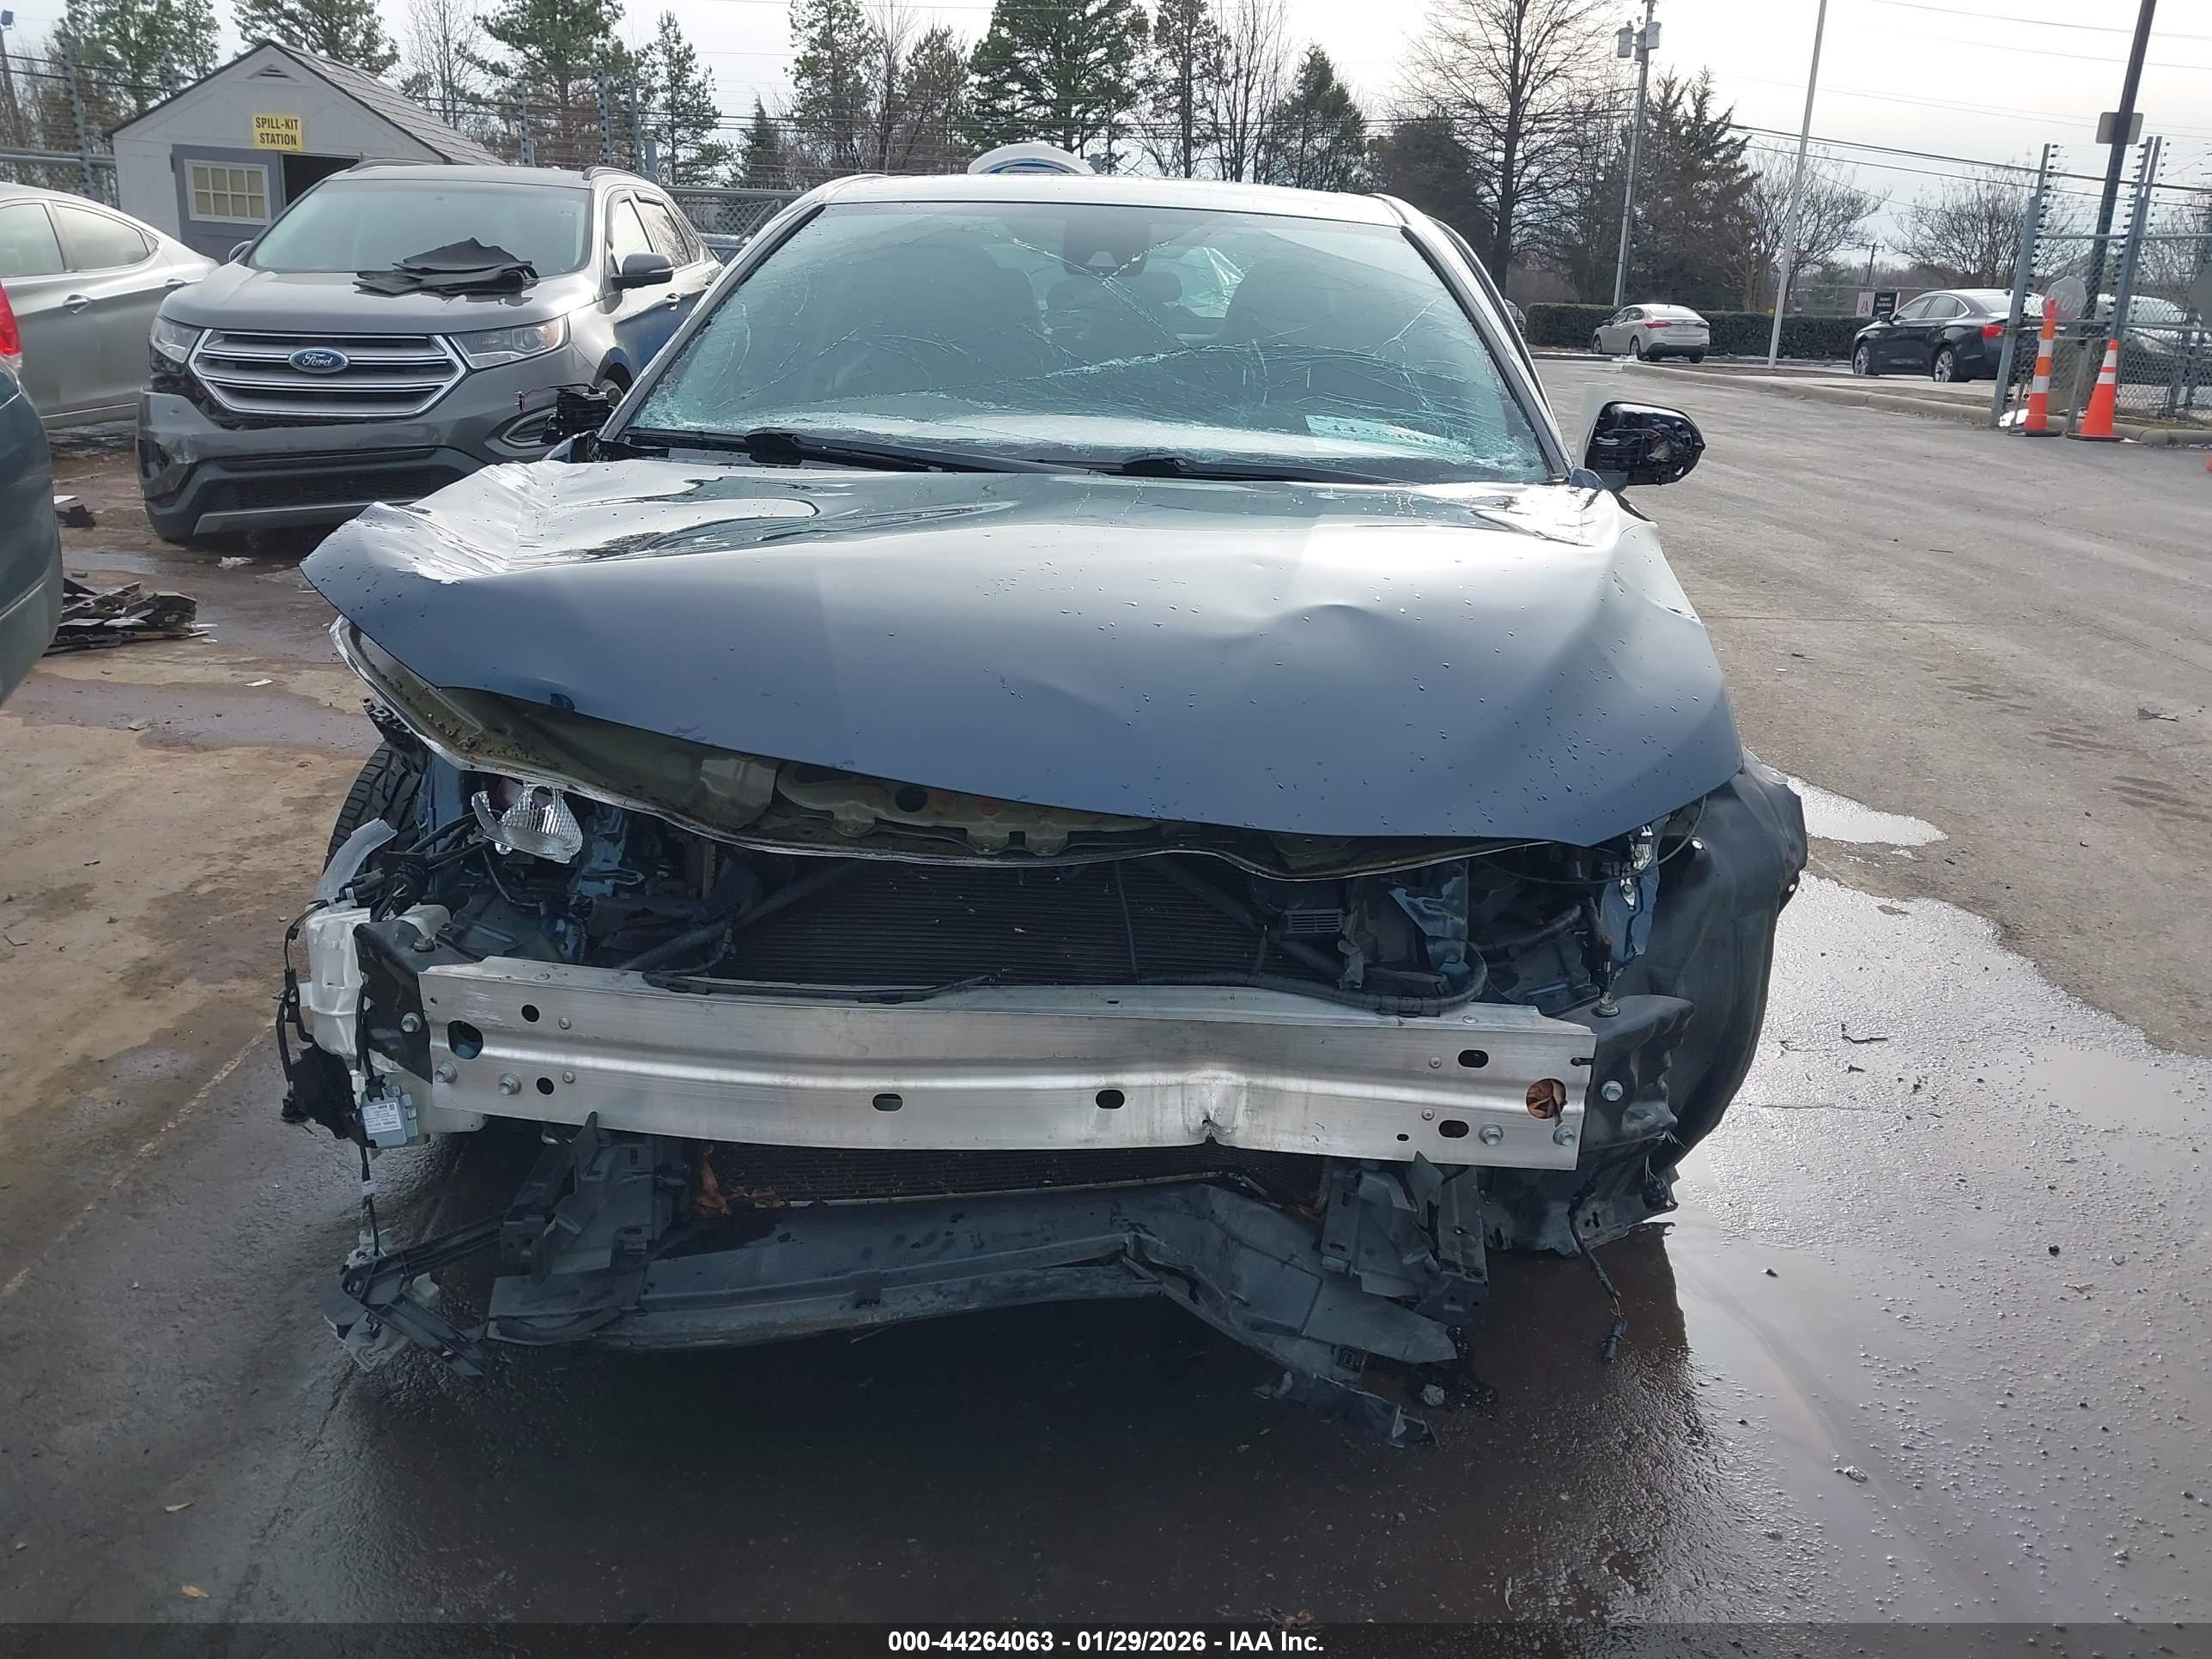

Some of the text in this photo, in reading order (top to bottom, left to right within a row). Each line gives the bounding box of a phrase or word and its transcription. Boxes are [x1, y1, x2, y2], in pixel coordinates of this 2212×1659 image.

[255, 117, 299, 131] SPILL-KIT
[259, 132, 297, 145] STATION
[302, 352, 334, 367] Ford
